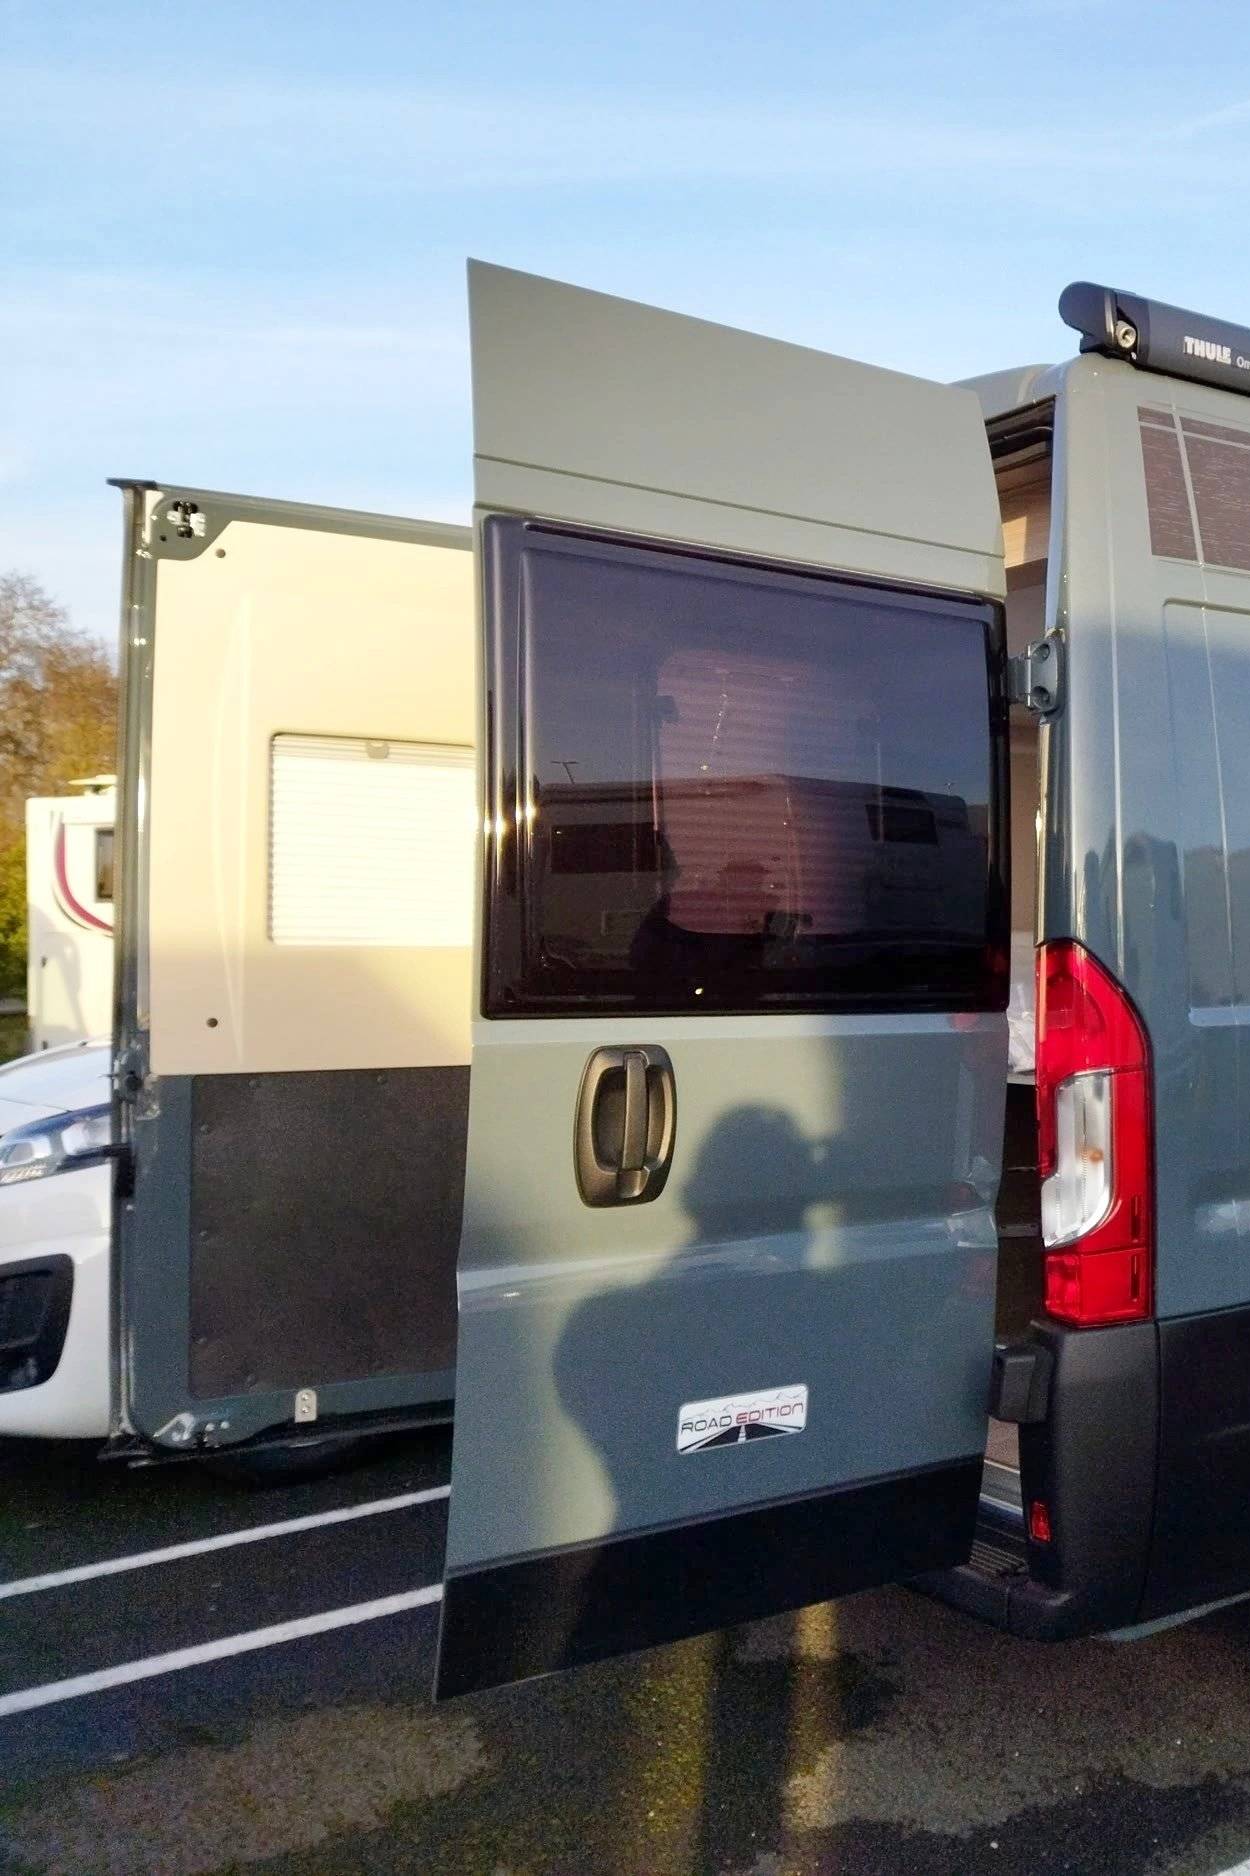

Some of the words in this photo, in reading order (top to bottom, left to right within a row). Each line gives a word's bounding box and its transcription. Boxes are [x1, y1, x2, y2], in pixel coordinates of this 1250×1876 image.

[1183, 336, 1232, 365] THULE
[681, 1415, 732, 1434] ROAD
[736, 1403, 804, 1425] EDITION
